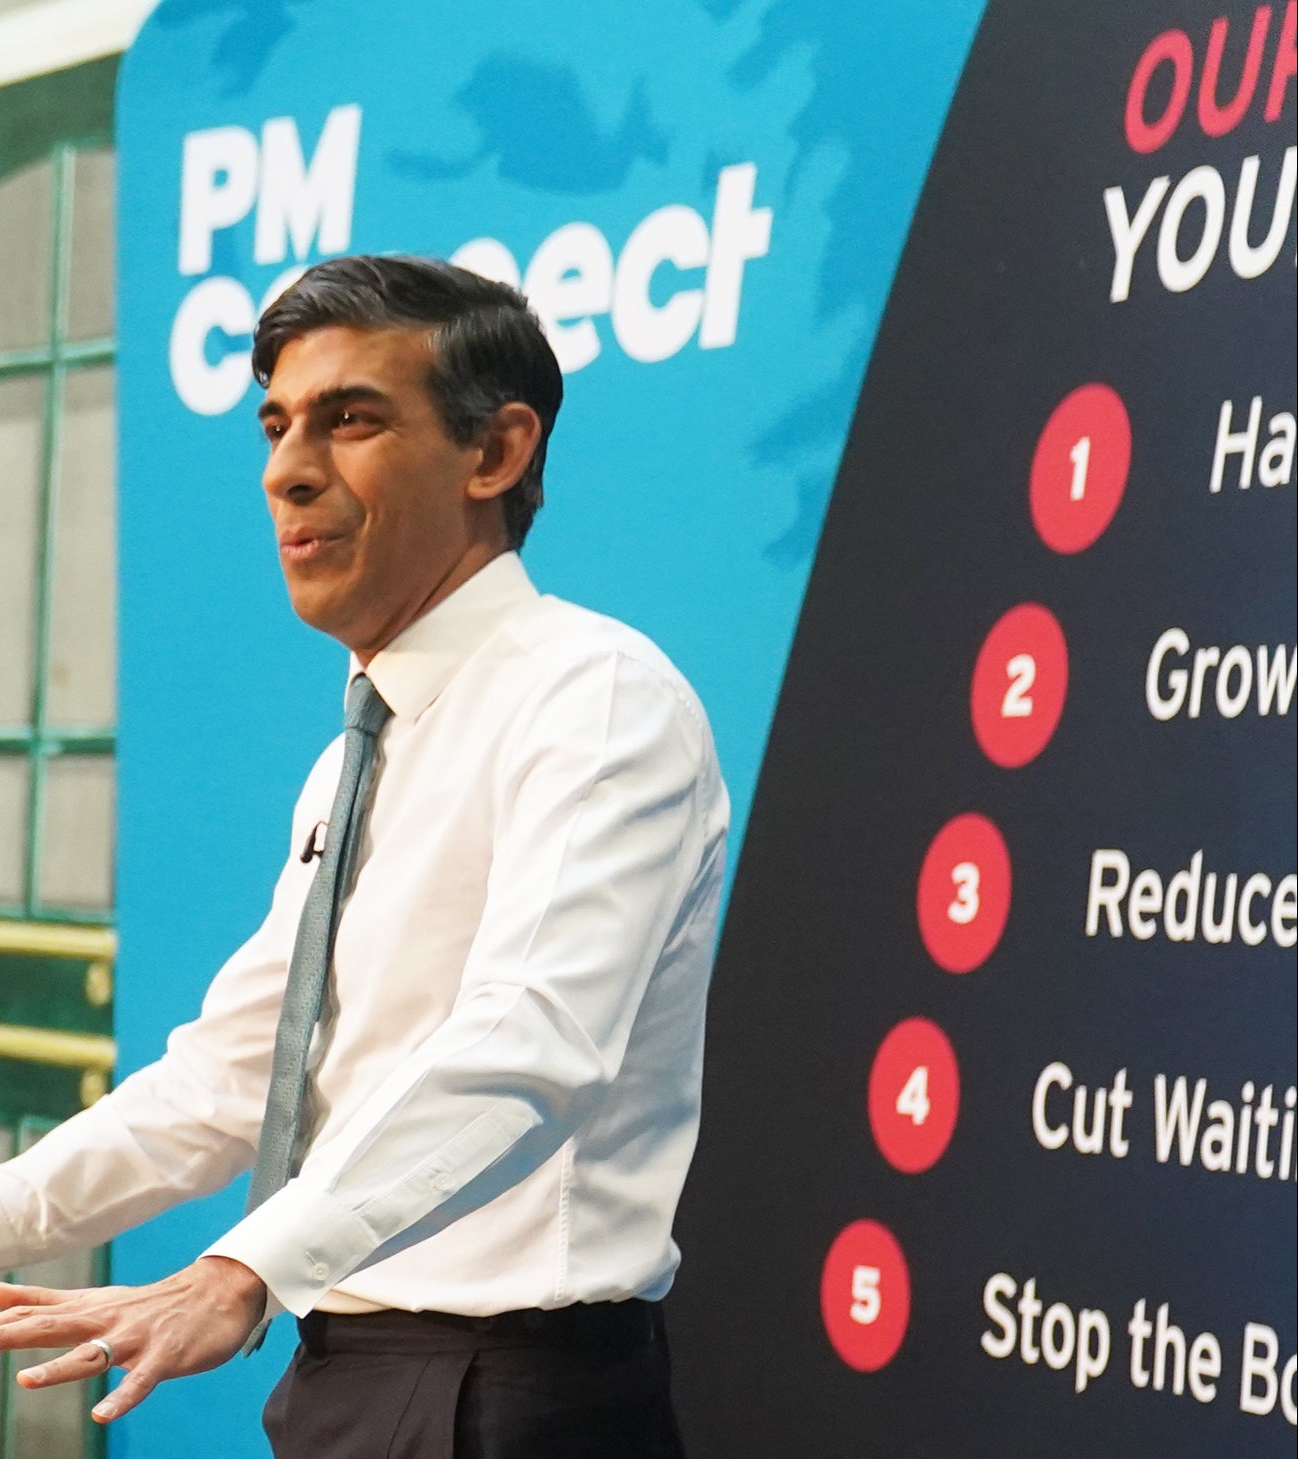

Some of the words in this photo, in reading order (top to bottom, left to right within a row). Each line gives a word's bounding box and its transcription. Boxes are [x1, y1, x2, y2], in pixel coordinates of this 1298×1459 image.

[179, 104, 362, 275] PM
[1103, 145, 1298, 303] YOU
[169, 161, 773, 416] Cect
[1069, 436, 1091, 501] 1
[1001, 653, 1036, 717] 2
[1145, 627, 1298, 721] Grow
[947, 862, 980, 924] 3
[1085, 848, 1298, 948] Reduce
[896, 1066, 930, 1125] 4
[1032, 1062, 1134, 1158] Cut
[1154, 1073, 1298, 1183] Waiti
[850, 1265, 881, 1325] 5
[980, 1273, 1111, 1394] Stop
[1127, 1298, 1222, 1404] the
